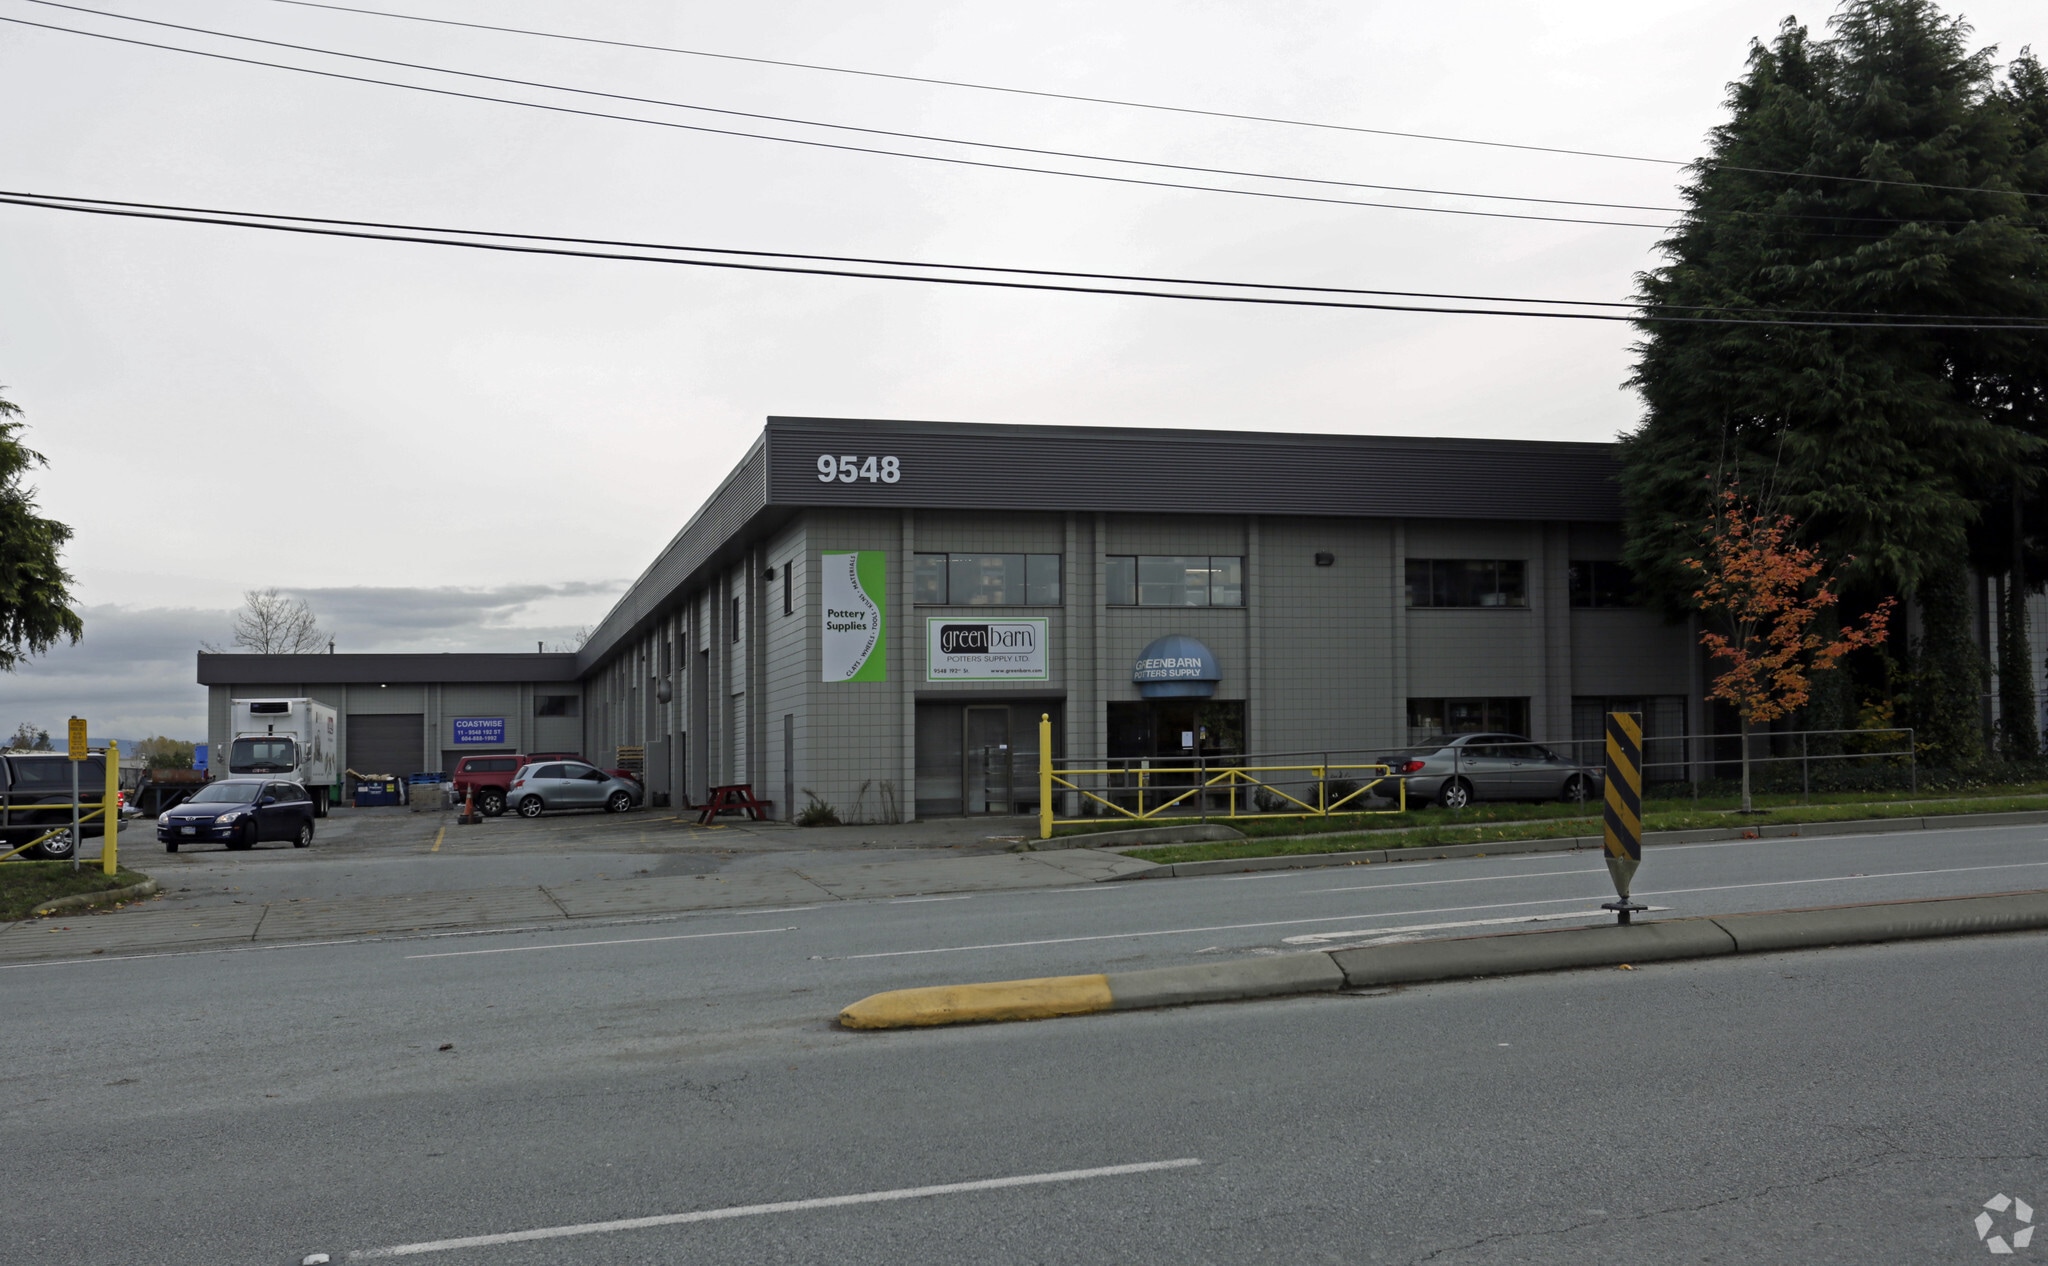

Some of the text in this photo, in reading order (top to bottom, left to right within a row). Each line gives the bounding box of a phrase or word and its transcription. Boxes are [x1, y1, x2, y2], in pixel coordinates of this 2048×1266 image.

[817, 454, 901, 484] 9548
[849, 555, 859, 590] MATERIALS
[858, 593, 873, 610] KILNS
[827, 608, 865, 621] Pottery
[826, 621, 867, 633] Supplies
[860, 635, 875, 657] WHEELS
[946, 655, 982, 663] POTTERS
[984, 655, 1013, 663] SUPPLY
[1135, 657, 1202, 671] GREENBARN
[846, 660, 861, 677] CLAYS
[1133, 668, 1201, 679] POTTERS SUPPLY
[456, 720, 503, 728] COASTWISE
